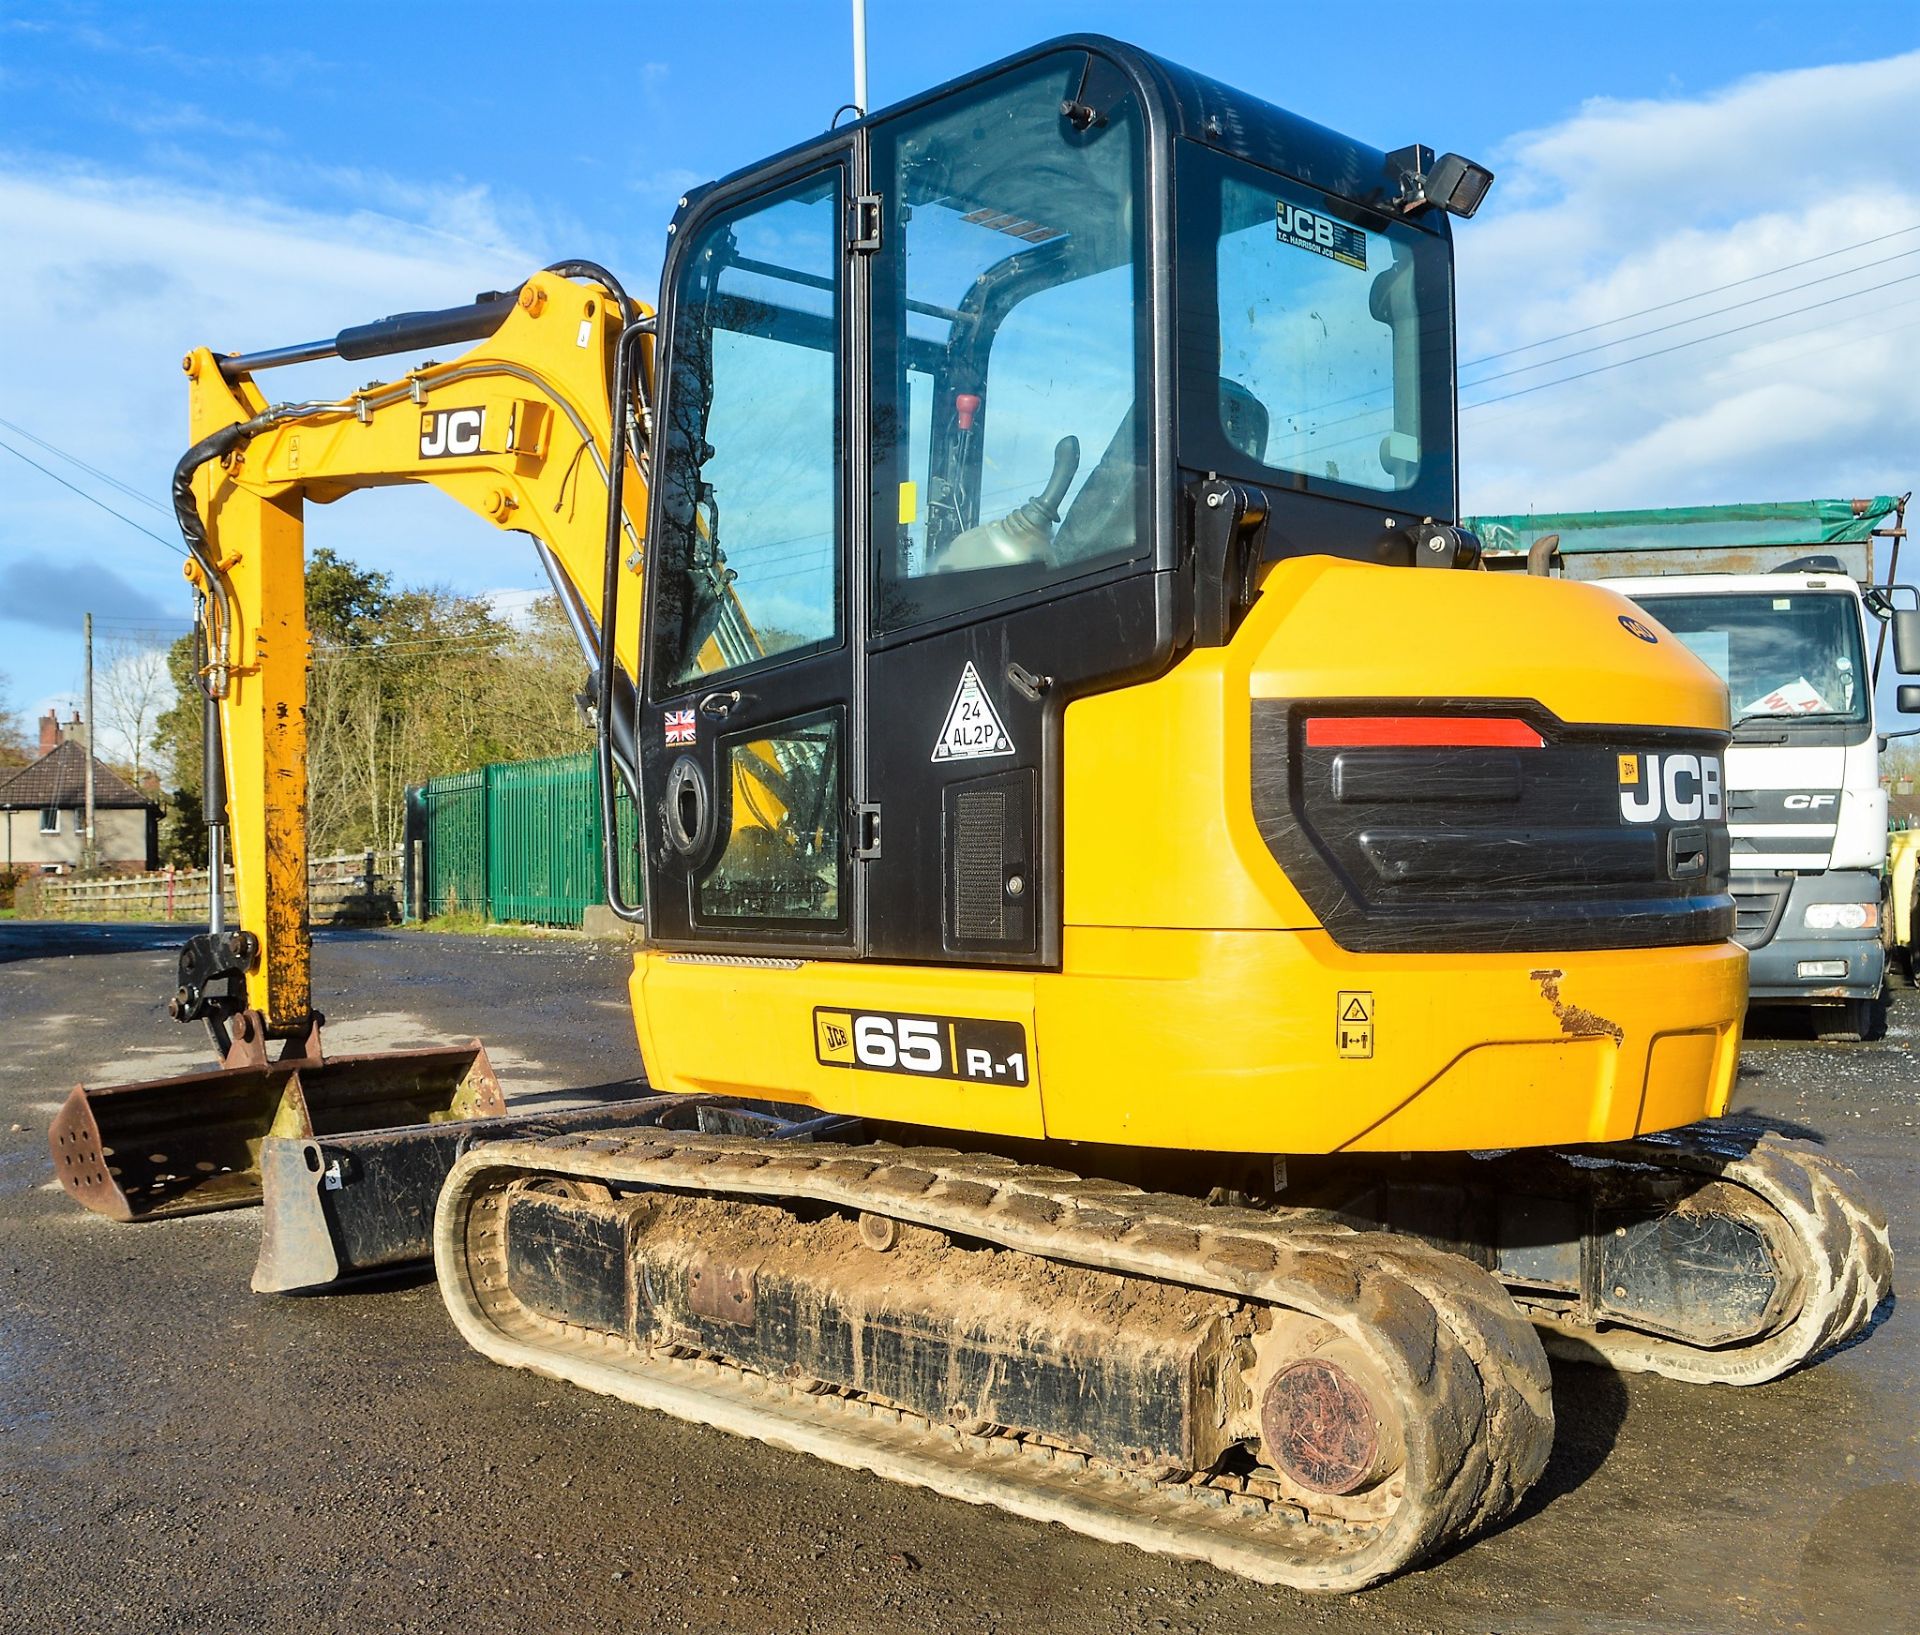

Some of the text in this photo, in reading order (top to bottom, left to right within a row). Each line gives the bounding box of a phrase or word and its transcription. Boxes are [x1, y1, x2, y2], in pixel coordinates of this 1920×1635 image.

[1278, 205, 1334, 247] JCB
[1277, 232, 1289, 243] T.C.
[1290, 236, 1321, 254] HARRISON
[1322, 246, 1334, 259] JCB
[421, 410, 514, 456] JC
[962, 701, 981, 721] 24
[953, 724, 994, 746] AL2P
[1620, 754, 1722, 823] JCB
[1783, 794, 1836, 809] CF
[826, 1025, 848, 1048] JCB
[854, 1016, 1025, 1082] 65 R-1
